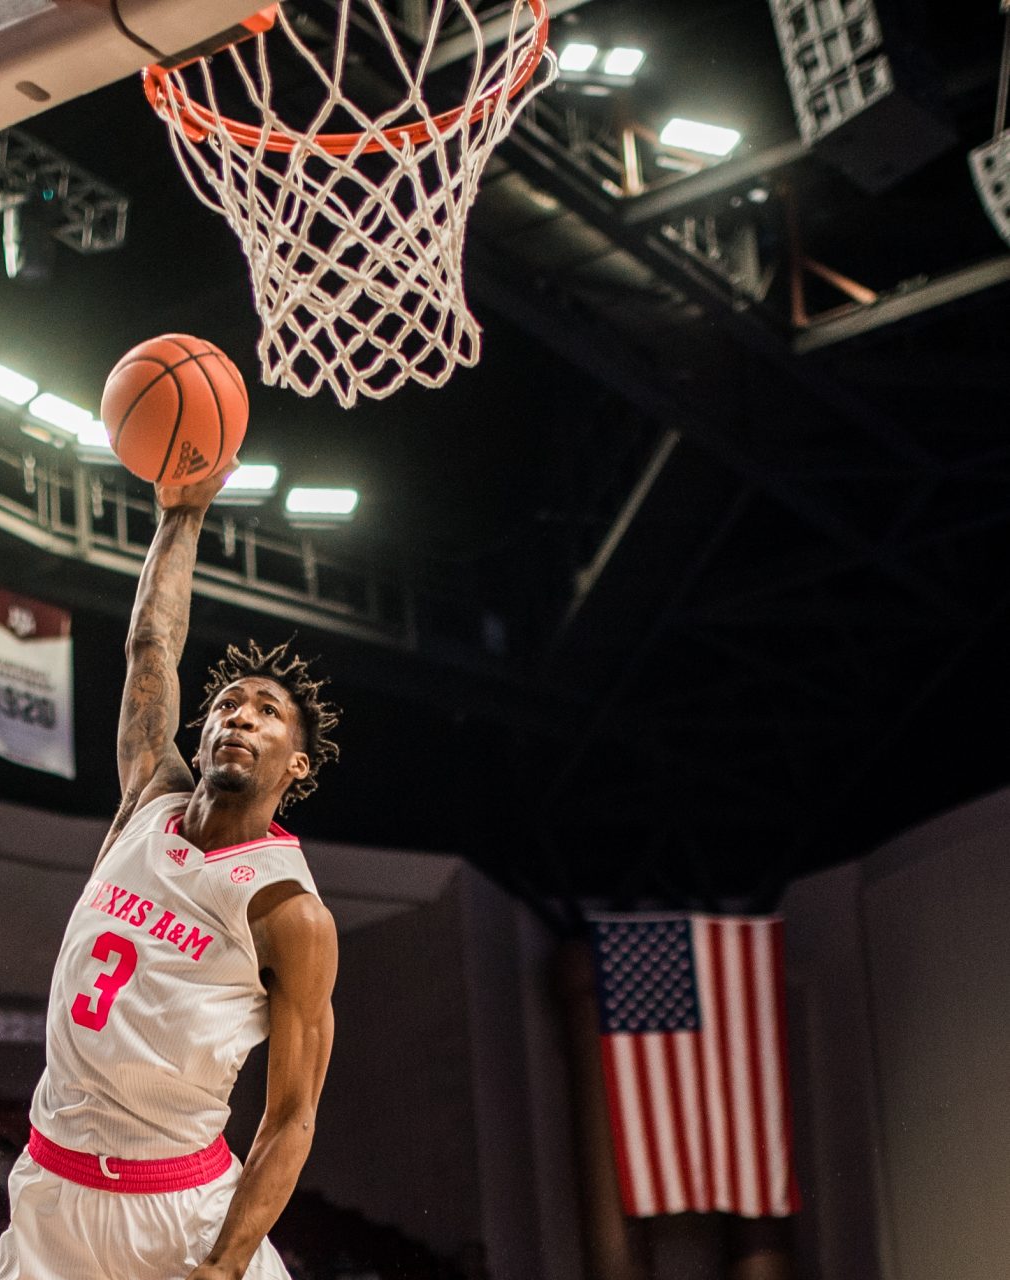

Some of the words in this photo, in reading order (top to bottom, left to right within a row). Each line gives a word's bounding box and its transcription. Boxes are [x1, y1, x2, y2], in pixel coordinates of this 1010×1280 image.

[83, 879, 154, 927] TEXAS
[148, 910, 214, 961] A&M
[71, 931, 138, 1033] 3
